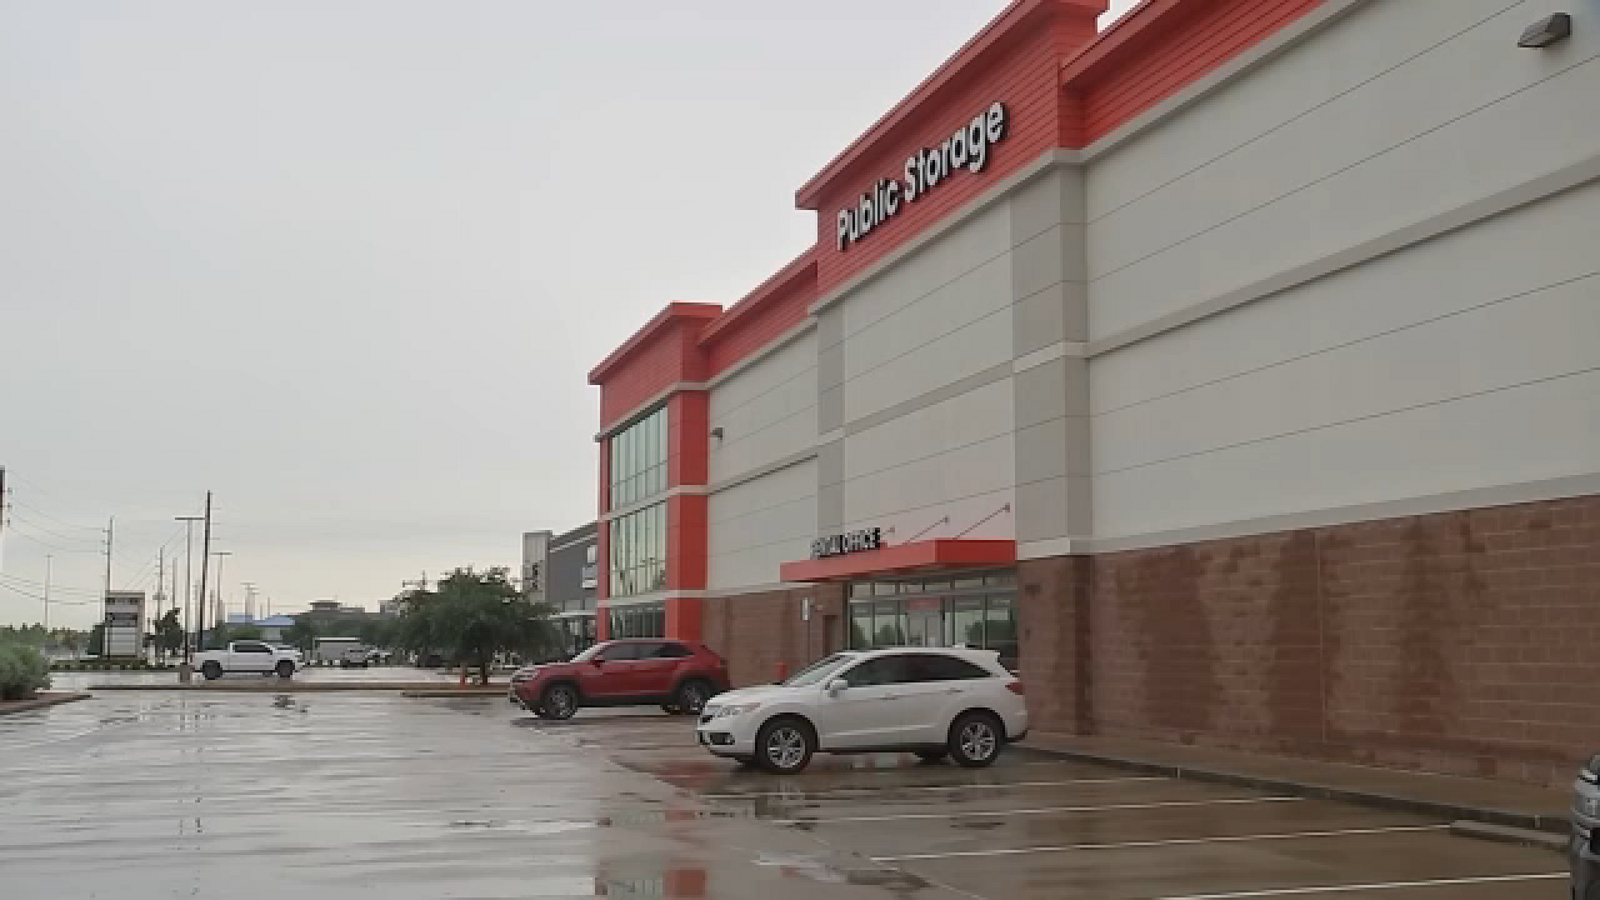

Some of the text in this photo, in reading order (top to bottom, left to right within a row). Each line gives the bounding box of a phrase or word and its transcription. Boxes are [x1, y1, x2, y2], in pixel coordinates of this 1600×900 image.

[836, 100, 1007, 252] Public Storage
[842, 526, 881, 554] OFFICE
